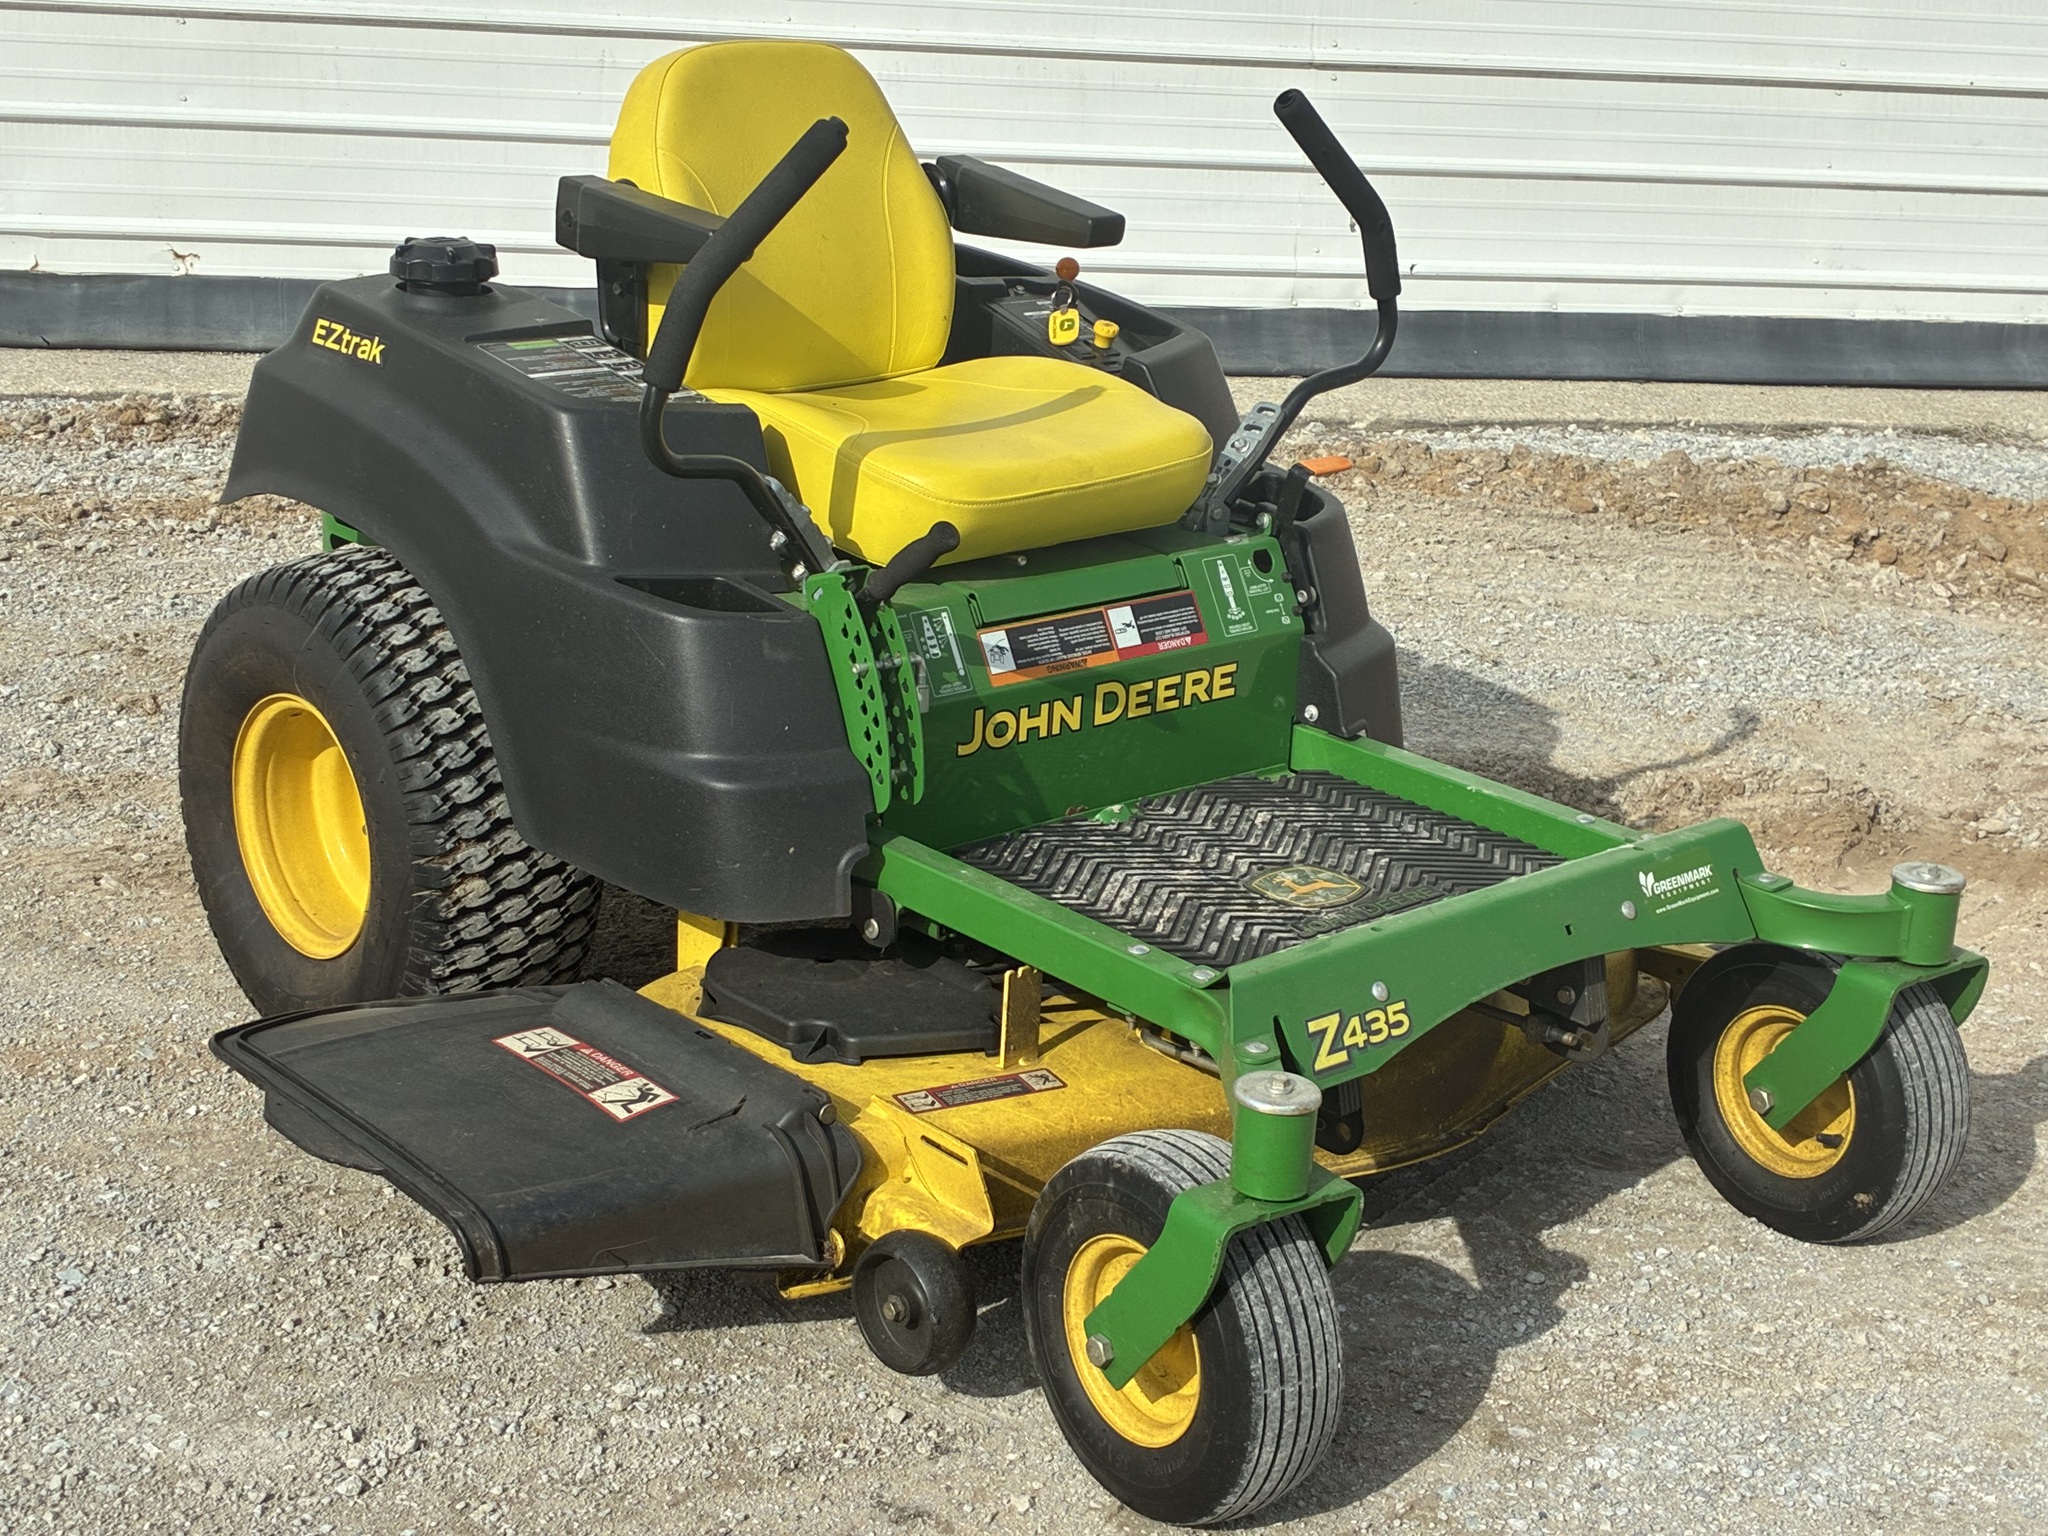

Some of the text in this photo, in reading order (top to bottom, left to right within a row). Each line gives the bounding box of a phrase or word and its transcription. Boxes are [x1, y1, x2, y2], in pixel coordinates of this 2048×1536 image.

[312, 318, 386, 365] EZtrak
[1157, 637, 1187, 651] DANGER
[1046, 659, 1084, 674] WARNING
[956, 661, 1238, 757] JOHN DEERE
[1653, 864, 1713, 895] GREENMARK
[1660, 877, 1711, 900] EQUIPMENT
[1298, 886, 1442, 937] JOHN DEERE
[1306, 1000, 1411, 1072] Z435
[591, 1052, 635, 1076] DANGER
